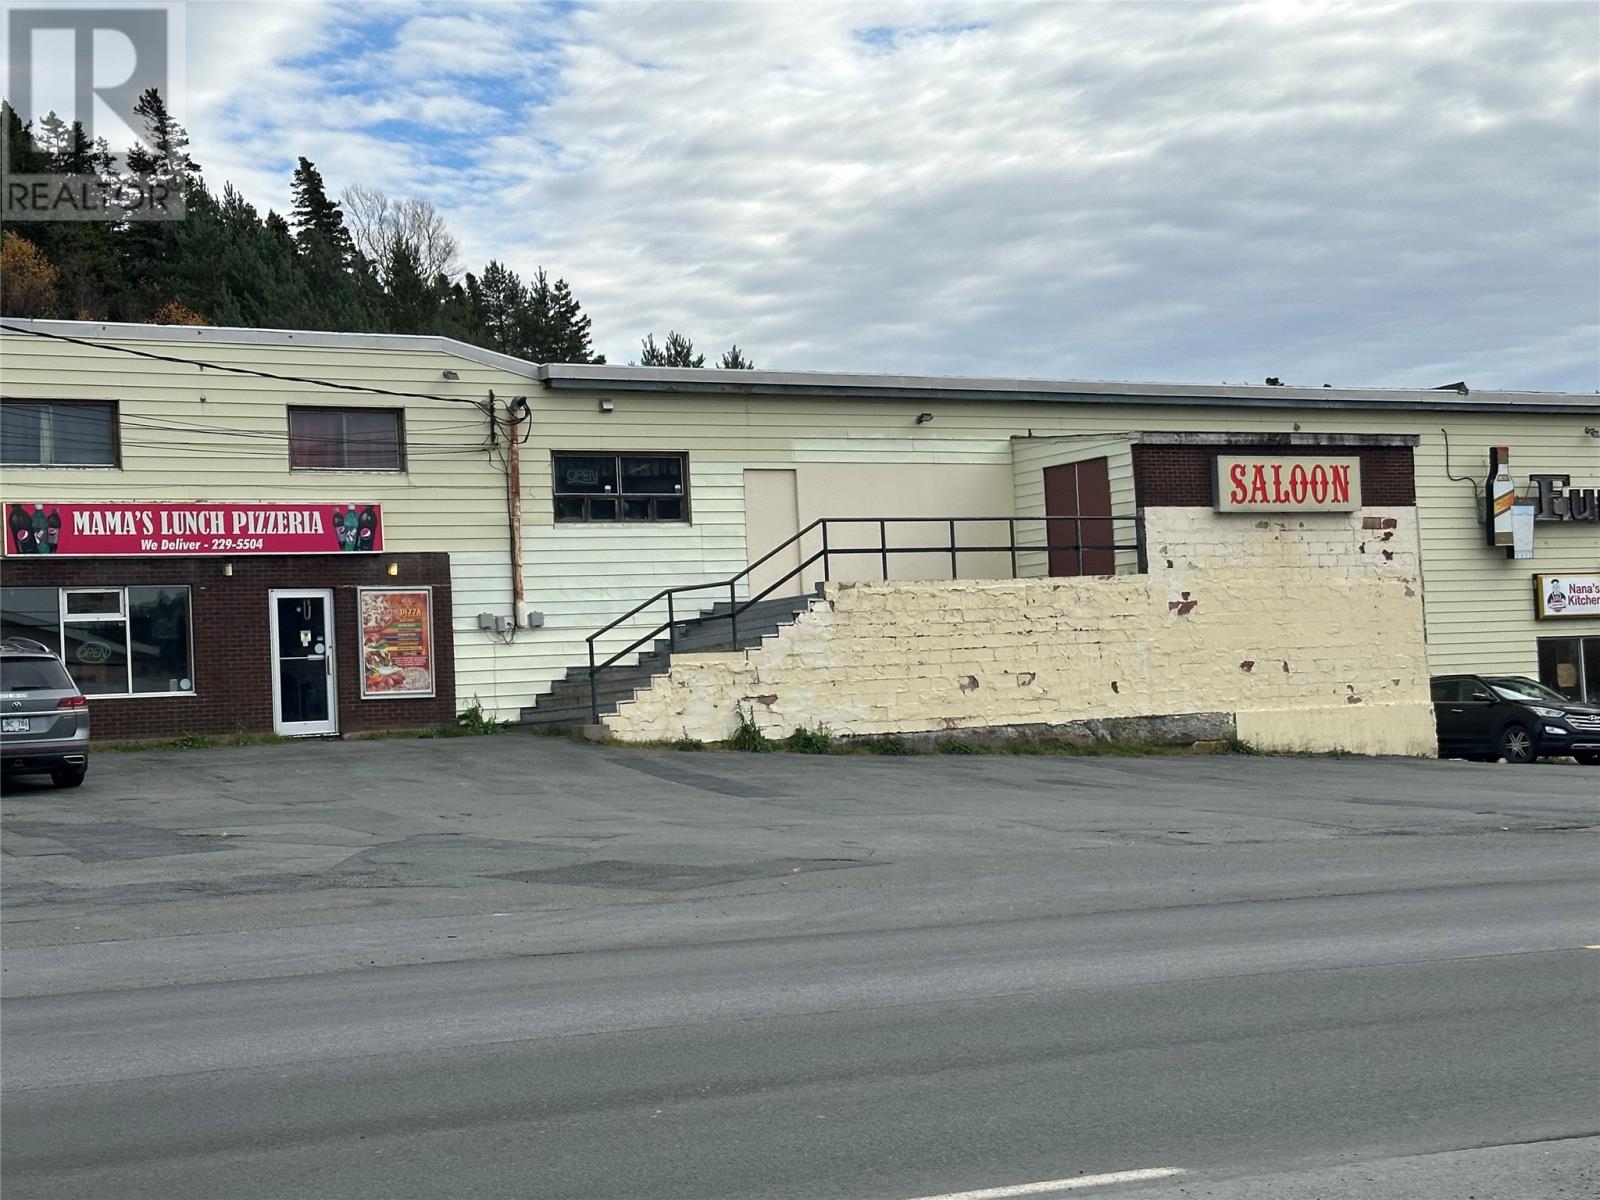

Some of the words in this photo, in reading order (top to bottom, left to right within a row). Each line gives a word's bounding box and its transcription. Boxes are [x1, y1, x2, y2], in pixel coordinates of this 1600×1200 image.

[566, 468, 599, 482] OPEN
[1230, 463, 1350, 505] SALOON
[72, 510, 154, 536] MAMA'S
[160, 510, 225, 535] LUNCH
[231, 509, 324, 535] PIZZERIA
[141, 539, 158, 551] We
[161, 538, 201, 551] Deliver
[211, 538, 263, 550] 229-5504
[1568, 583, 1600, 594] Nana's
[80, 646, 108, 659] OPEN
